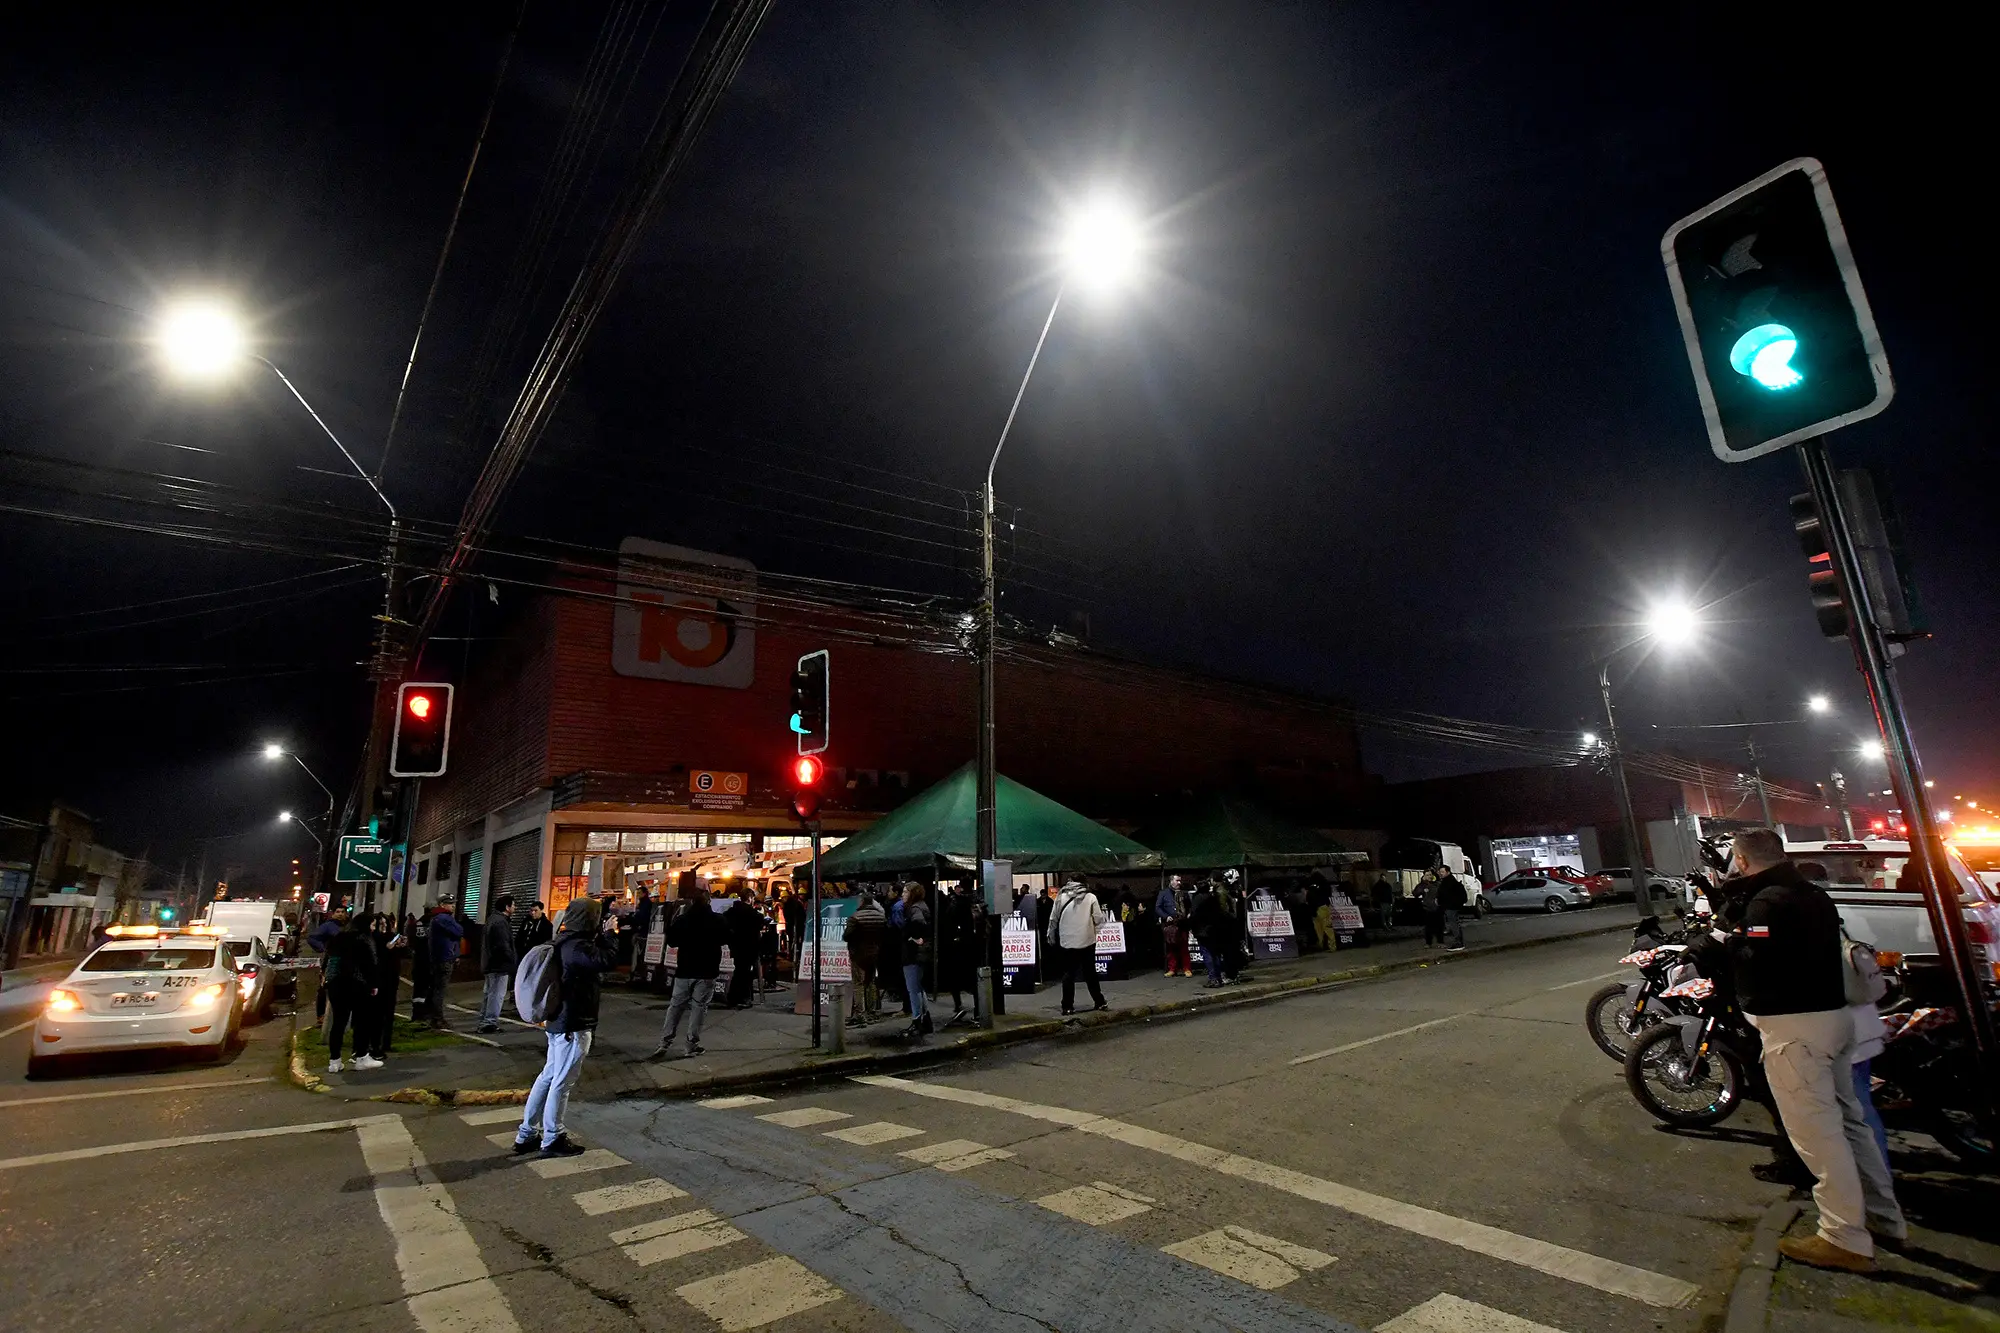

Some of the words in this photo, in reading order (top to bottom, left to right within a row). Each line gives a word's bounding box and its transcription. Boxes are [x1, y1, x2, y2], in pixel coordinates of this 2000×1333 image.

[630, 591, 735, 668] 10
[700, 776, 709, 787] E
[1251, 900, 1284, 911] ILUMINA
[163, 976, 198, 987] A-275
